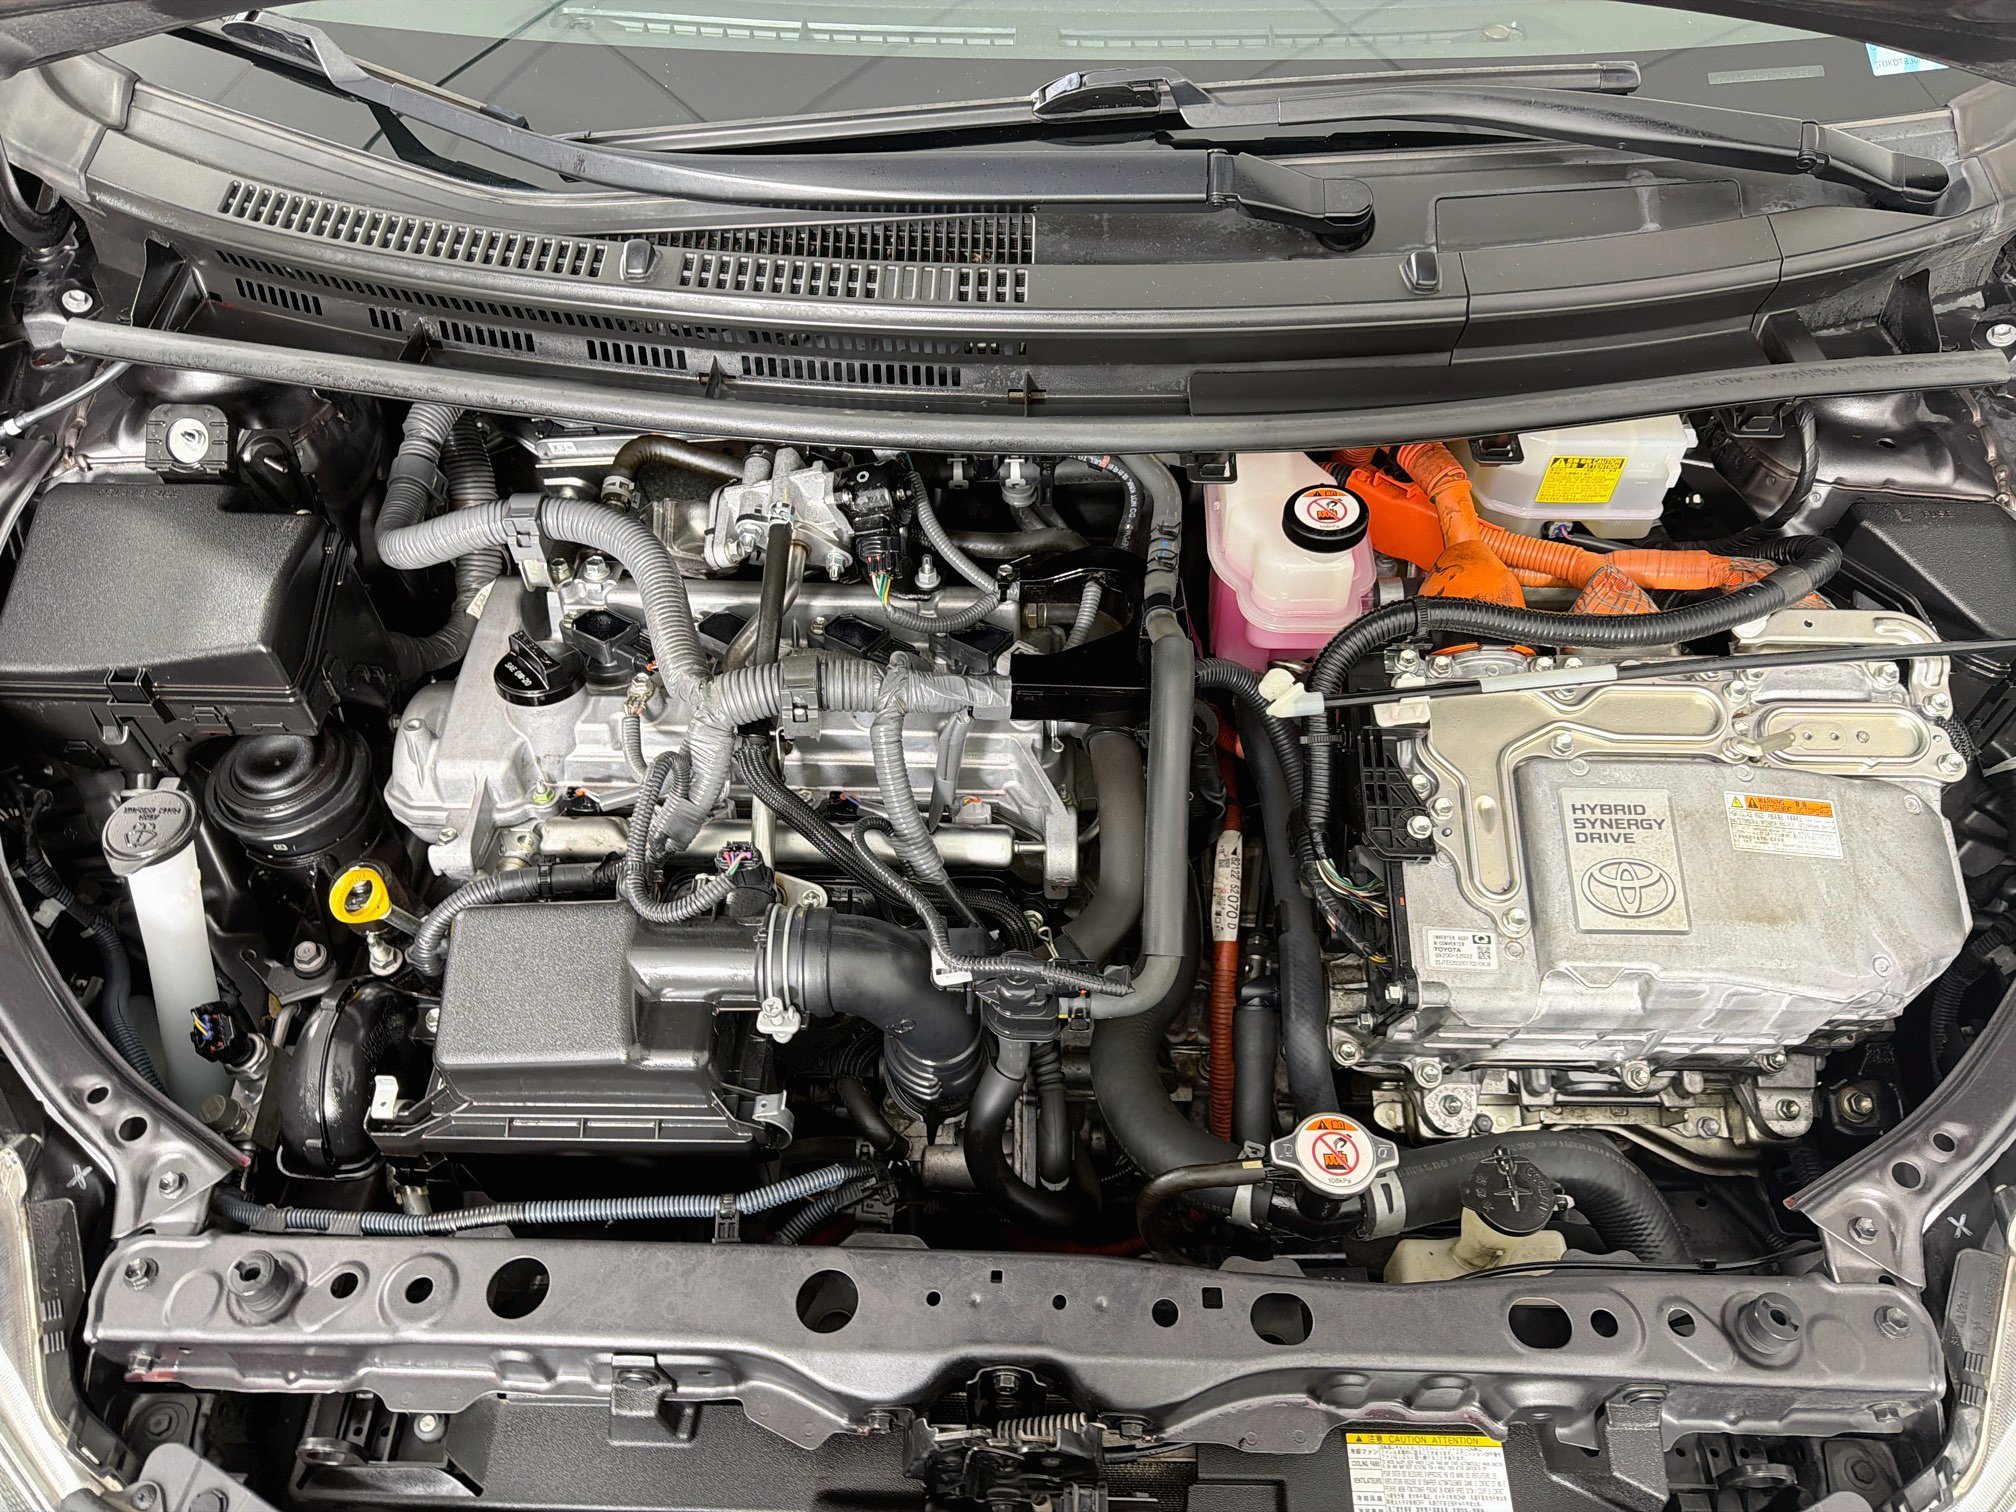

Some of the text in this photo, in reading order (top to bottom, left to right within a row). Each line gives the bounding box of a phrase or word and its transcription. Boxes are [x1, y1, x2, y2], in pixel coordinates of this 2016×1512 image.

[514, 670, 533, 687] 0W-20
[1571, 803, 1646, 816] HYBRID
[1573, 818, 1666, 830] SYNERGY
[1575, 832, 1636, 844] DRIVE
[1388, 1435, 1427, 1443] CAUTION
[1432, 1436, 1479, 1445] ATTENTION
